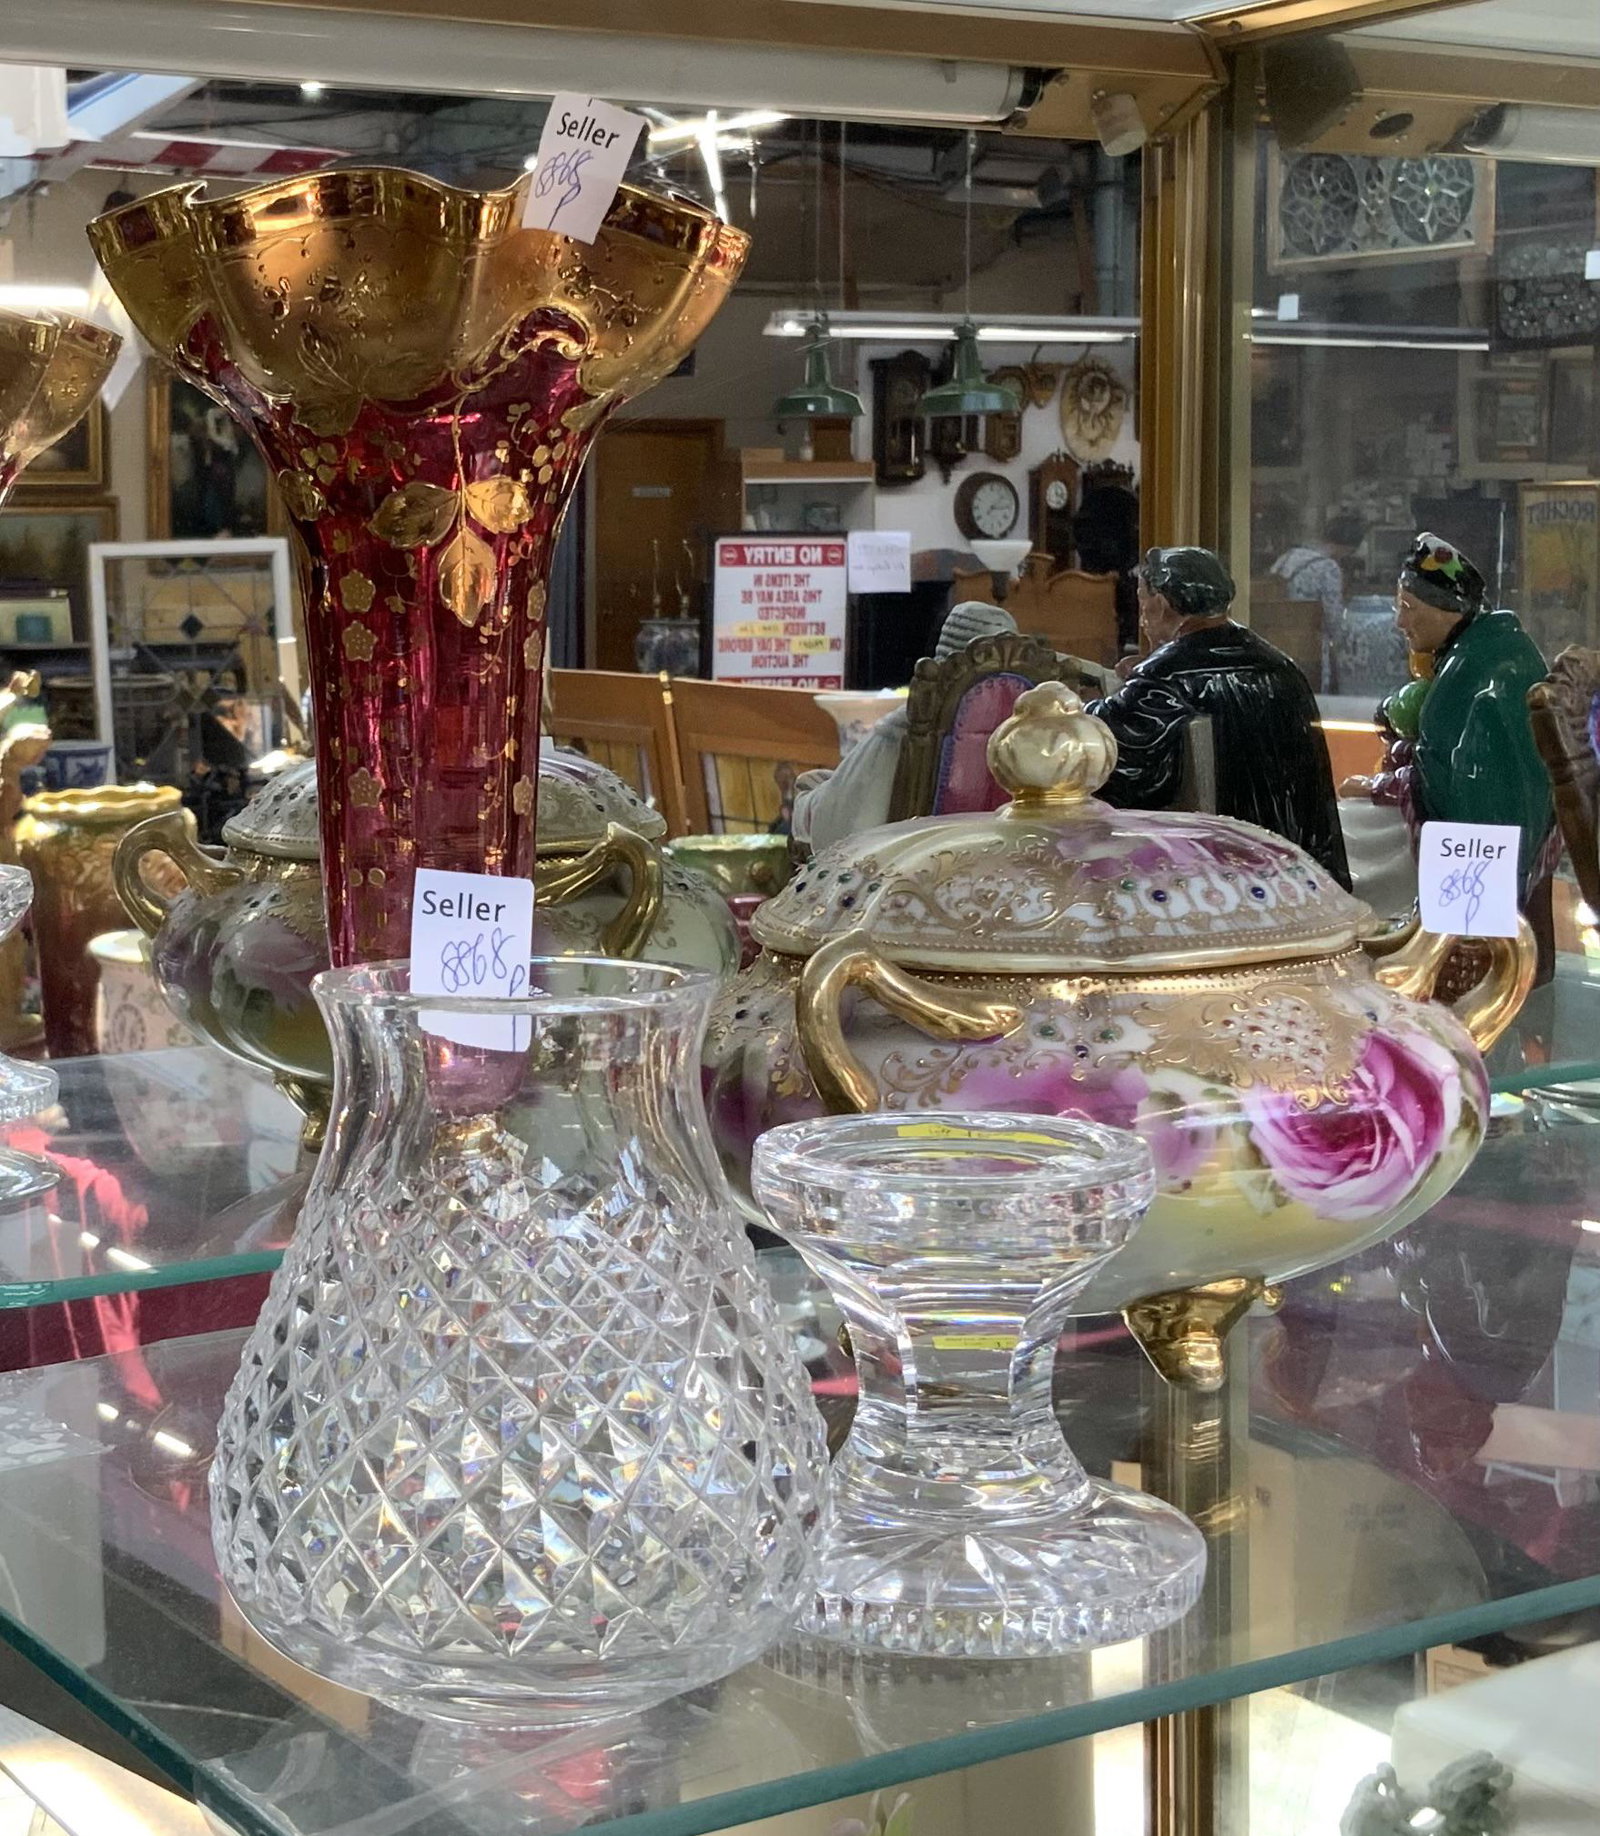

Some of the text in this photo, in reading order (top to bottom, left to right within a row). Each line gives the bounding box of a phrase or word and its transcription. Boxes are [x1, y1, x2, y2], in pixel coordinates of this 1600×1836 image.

[556, 112, 620, 150] Seller
[1440, 837, 1507, 860] Seller
[421, 890, 507, 923] Seller
